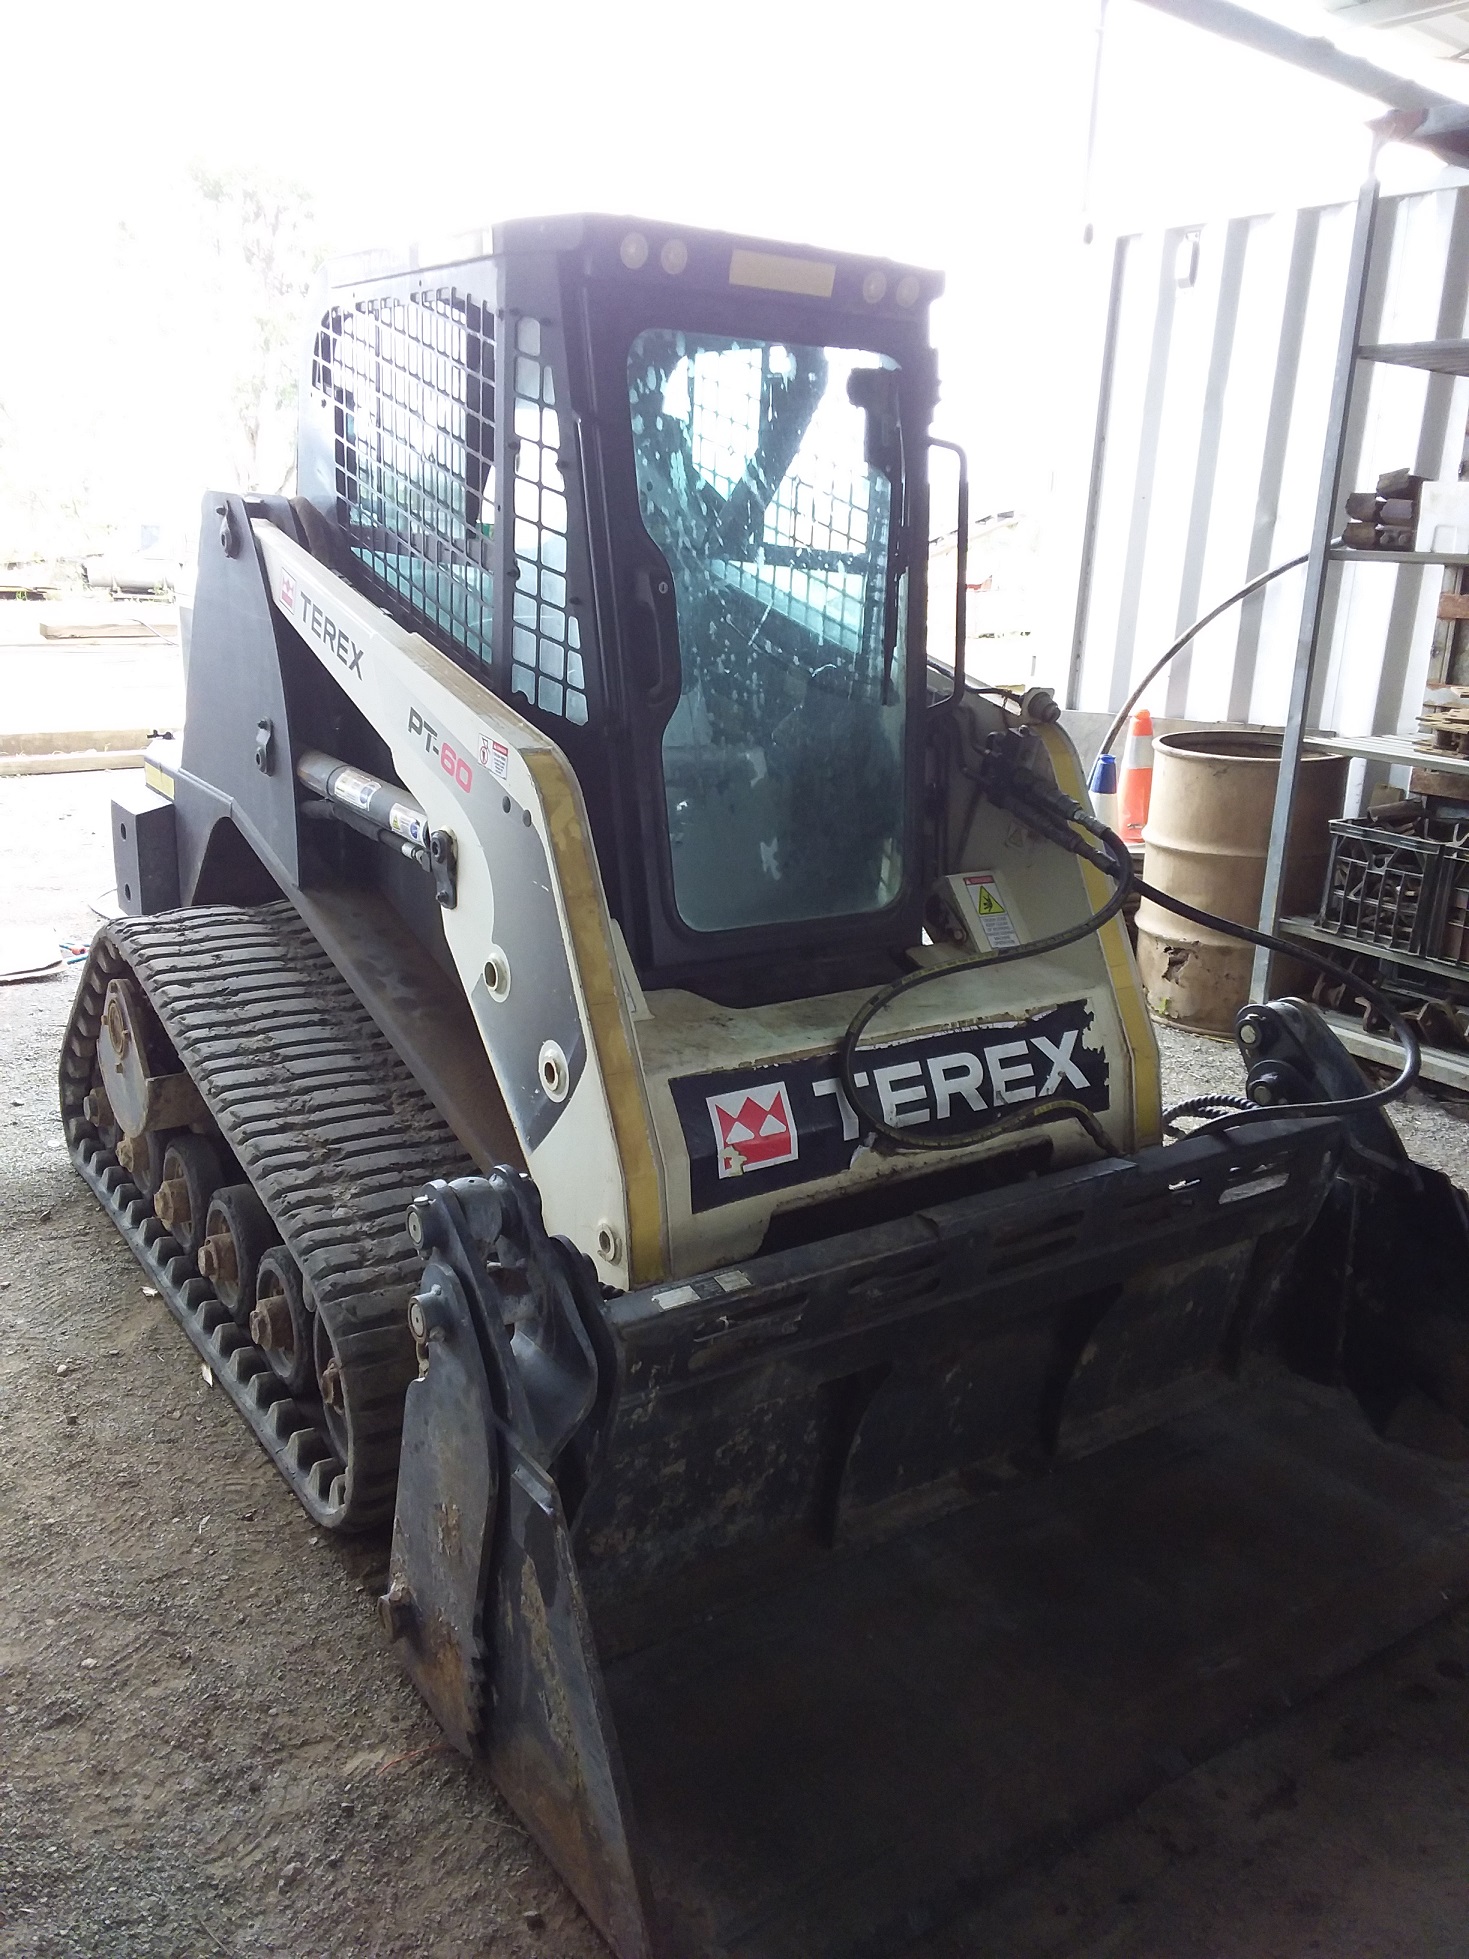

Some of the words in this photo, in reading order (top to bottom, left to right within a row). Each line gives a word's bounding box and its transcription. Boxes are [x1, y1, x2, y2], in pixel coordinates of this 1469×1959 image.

[300, 591, 365, 681] TEREX
[408, 706, 473, 794] PT-60
[812, 1029, 1092, 1142] TEREX
